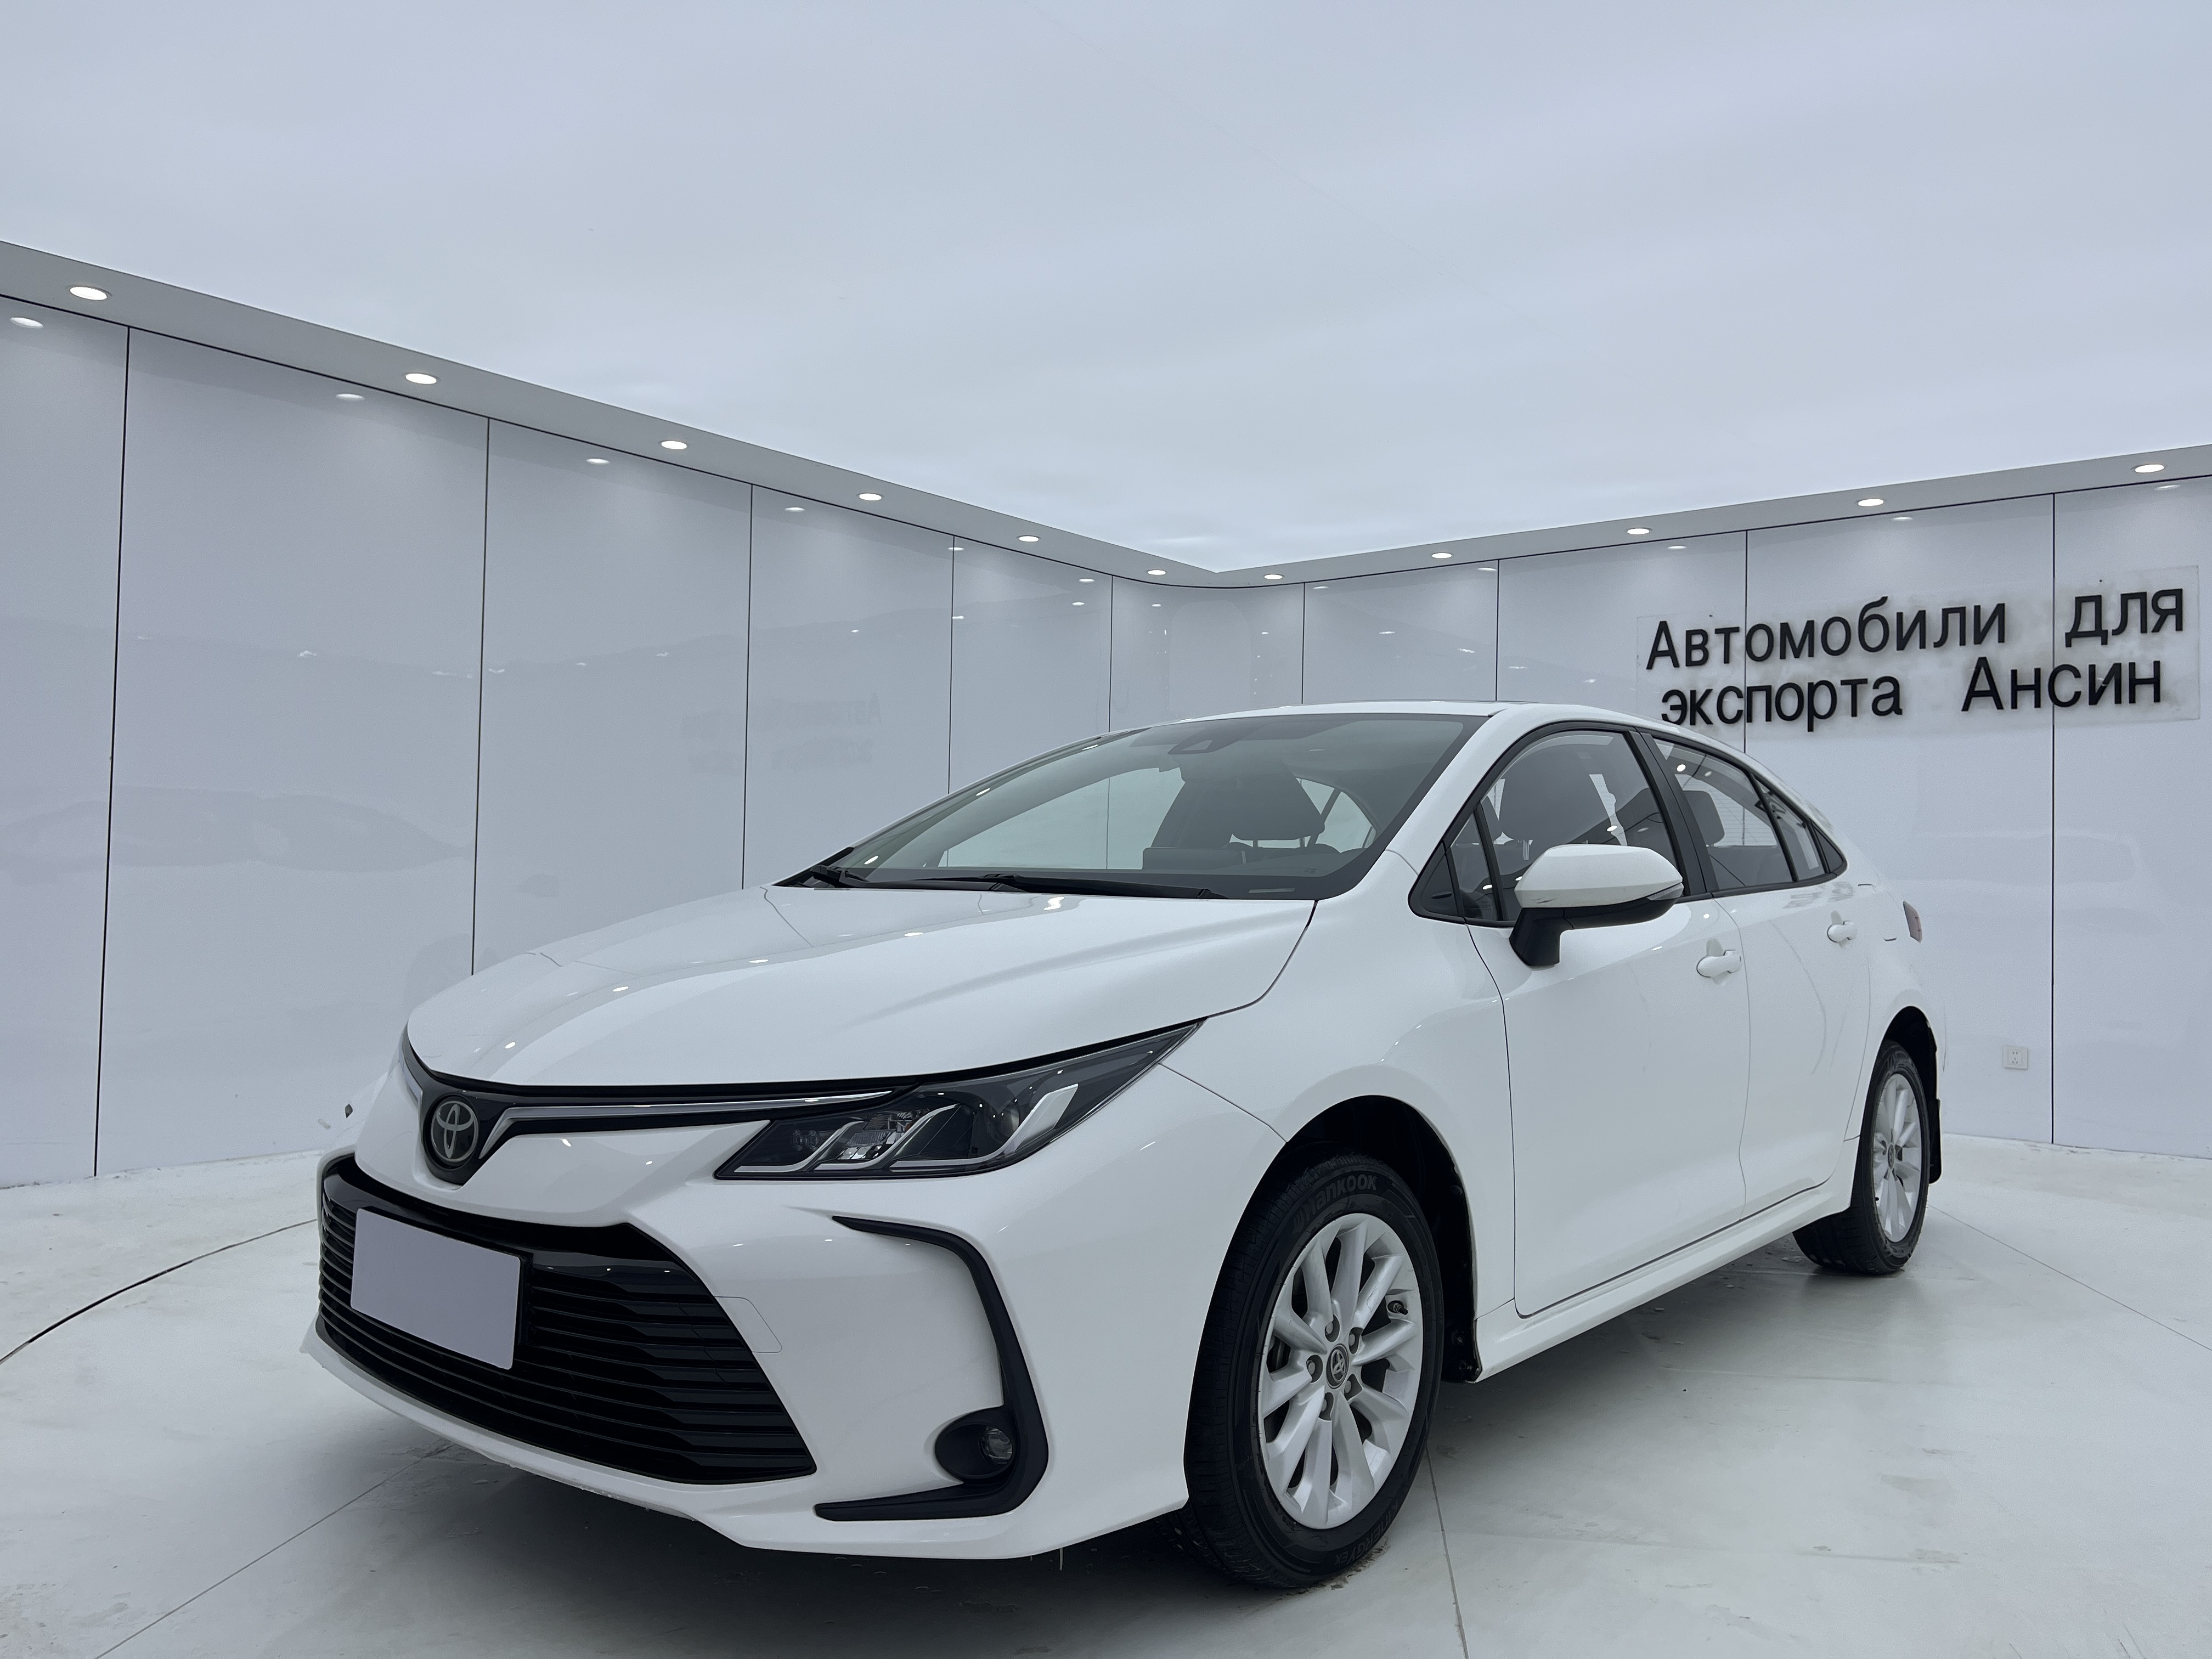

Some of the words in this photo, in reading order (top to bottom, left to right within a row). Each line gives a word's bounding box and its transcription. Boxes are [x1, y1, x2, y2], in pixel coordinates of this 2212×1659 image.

[1646, 596, 2006, 670] Автомобили
[2064, 588, 2183, 648] для
[1661, 676, 1903, 732] экспорта
[1961, 657, 2161, 712] Ансин
